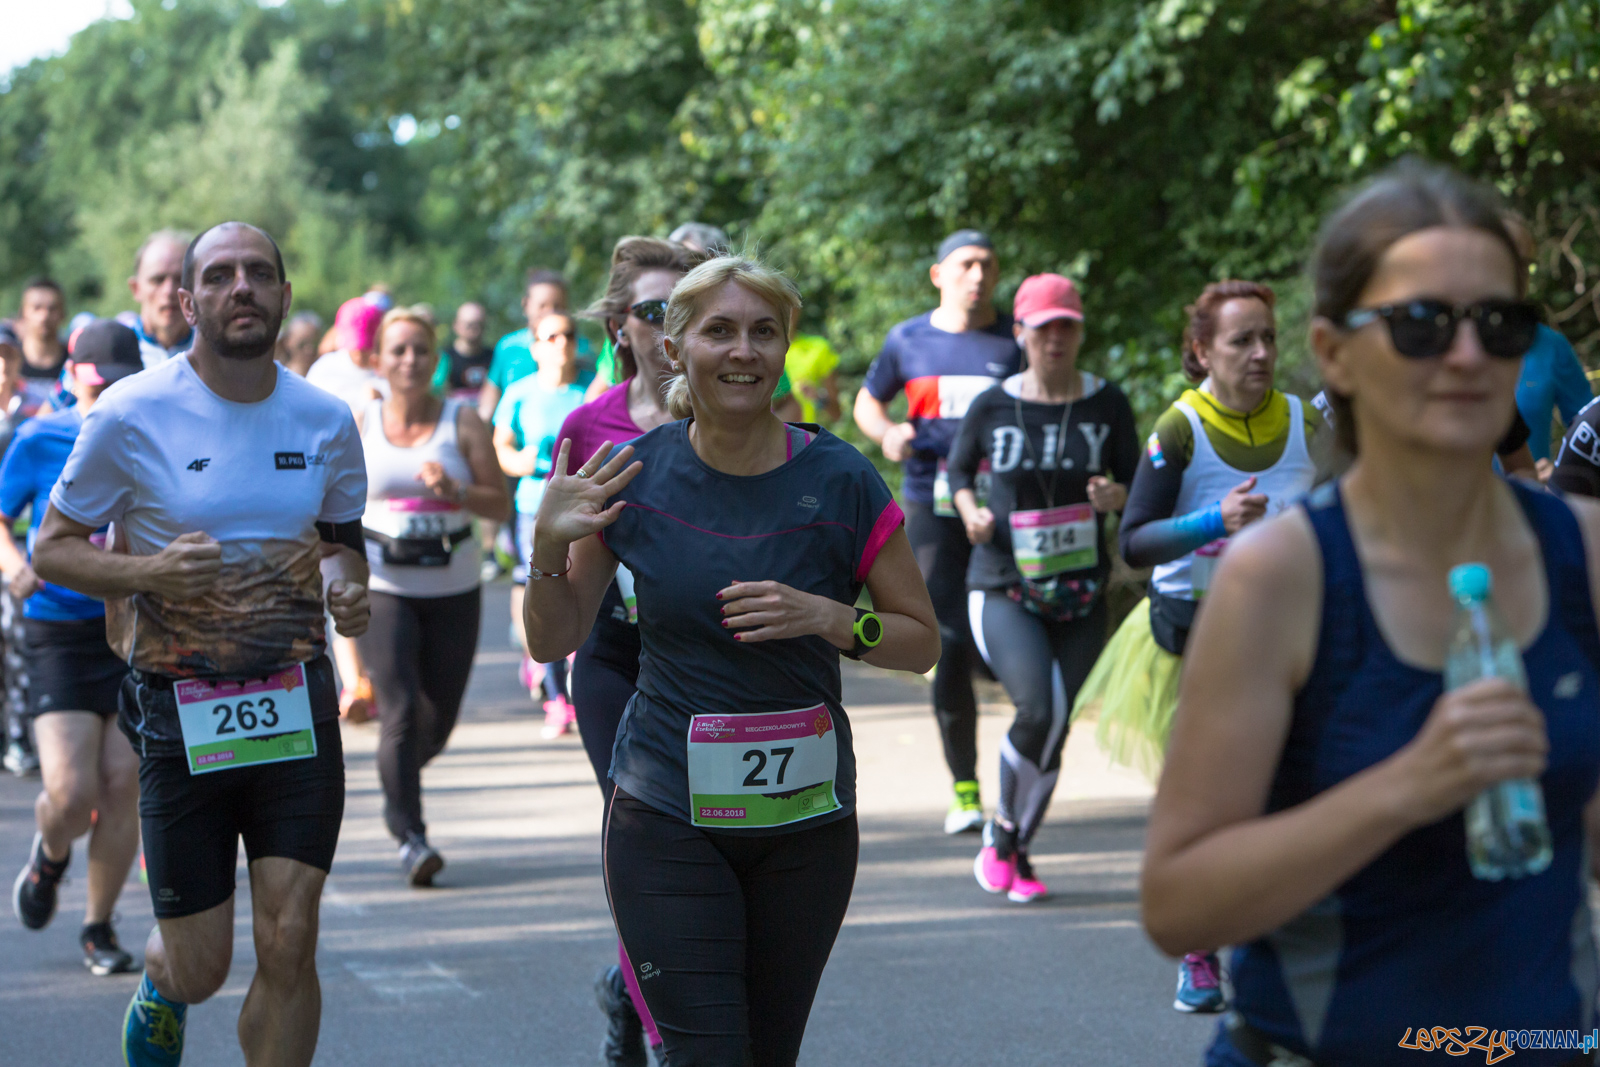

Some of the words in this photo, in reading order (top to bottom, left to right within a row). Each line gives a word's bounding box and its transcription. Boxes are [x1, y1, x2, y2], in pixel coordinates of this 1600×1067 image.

[991, 422, 1111, 473] D.I.Y
[187, 458, 211, 472] 4F
[1035, 528, 1076, 553] 214
[212, 697, 279, 735] 263
[742, 746, 794, 787] 27
[701, 808, 745, 817] 22.06.2018
